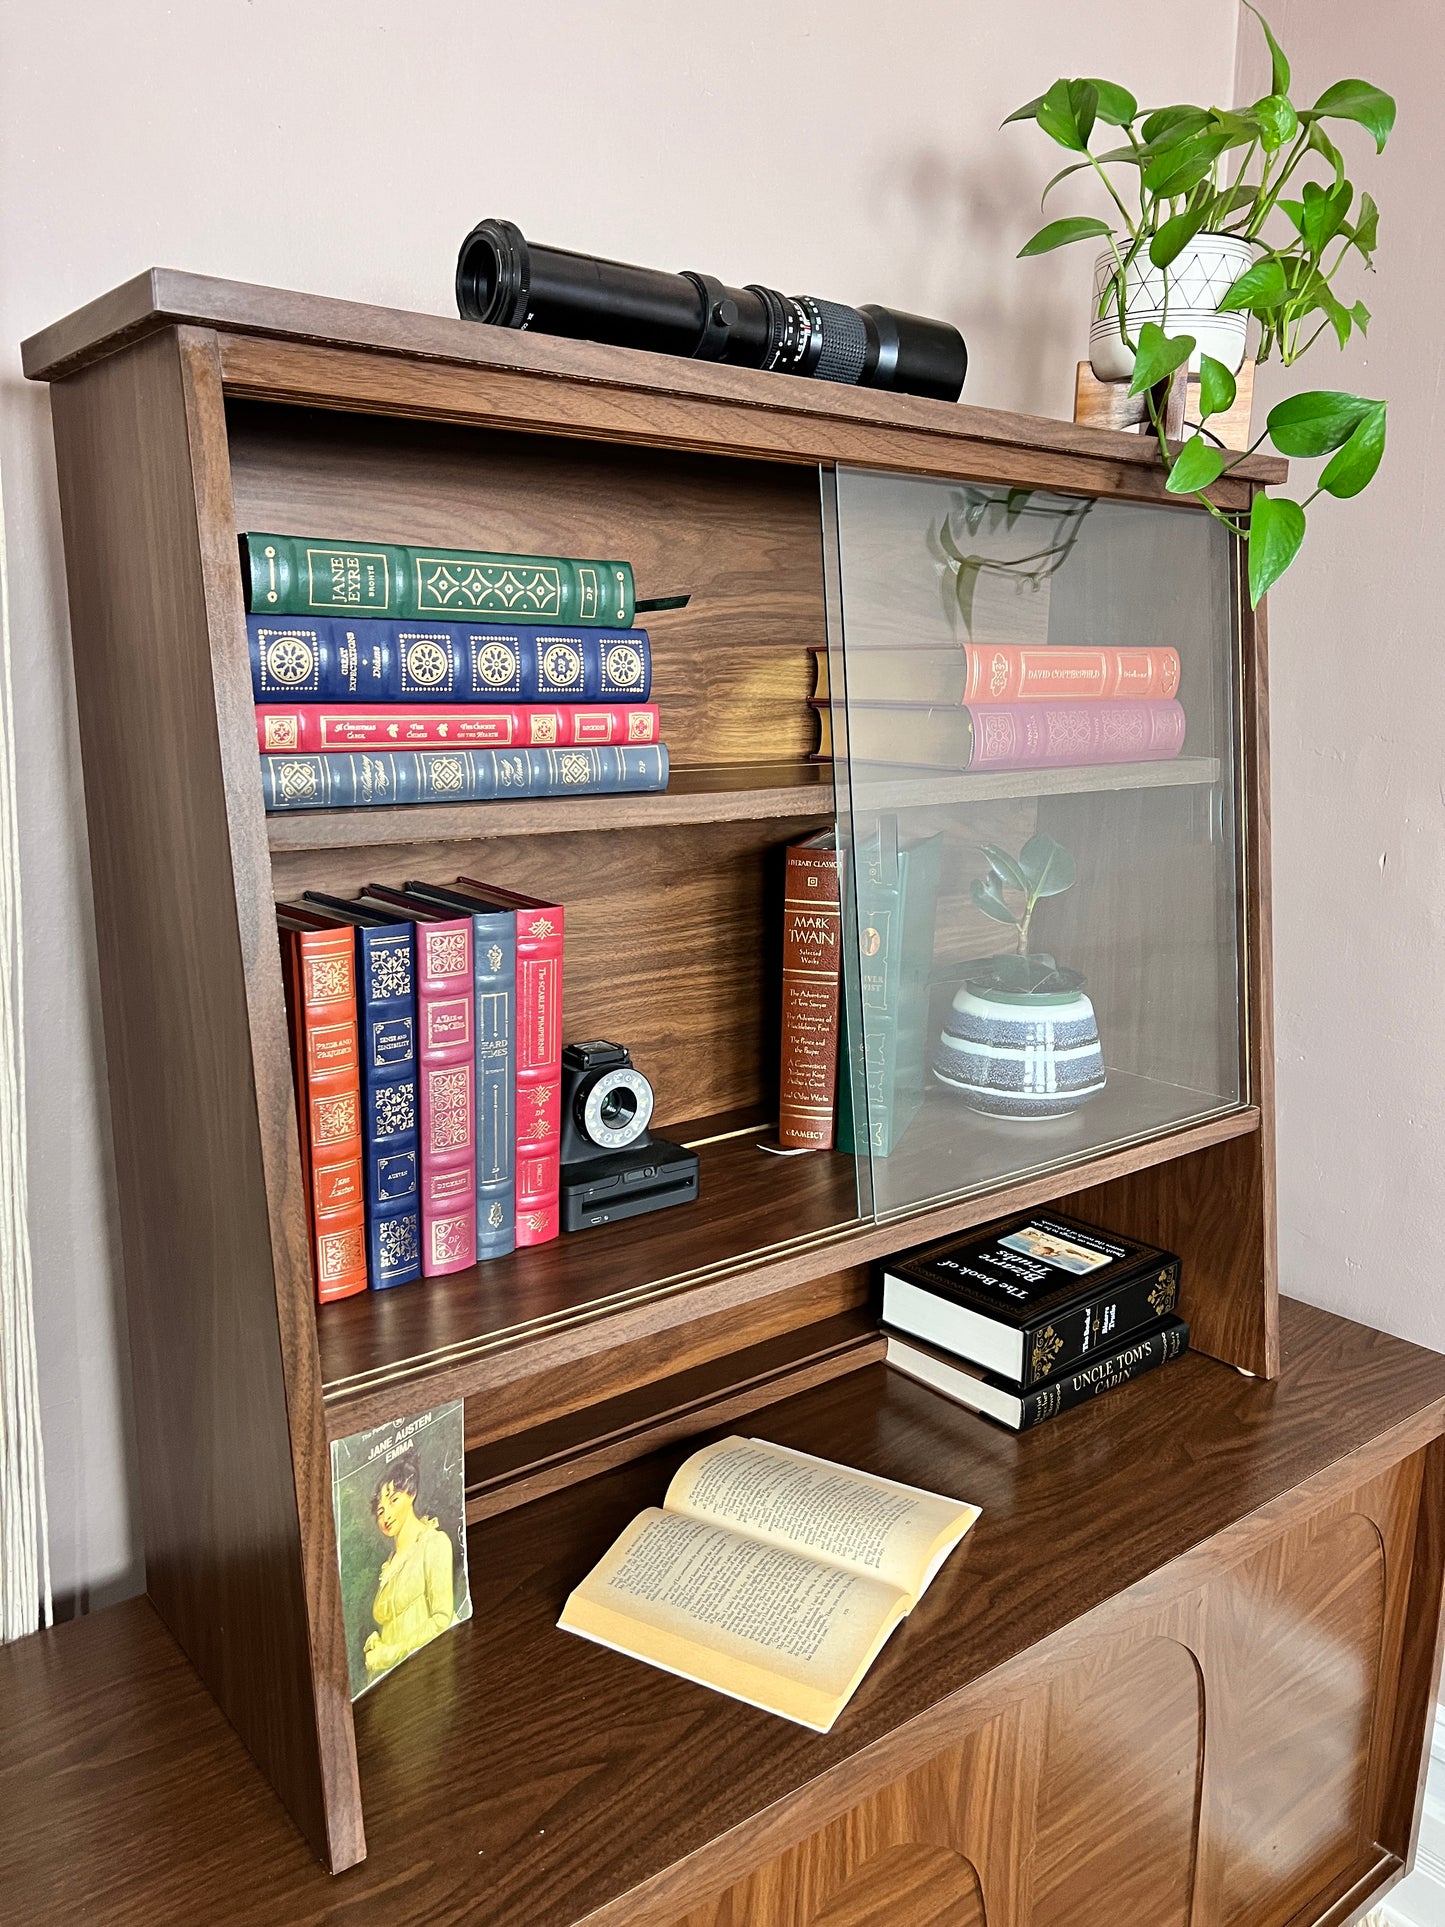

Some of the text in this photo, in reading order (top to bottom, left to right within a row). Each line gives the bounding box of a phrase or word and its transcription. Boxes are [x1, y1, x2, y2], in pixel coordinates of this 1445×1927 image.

[331, 557, 347, 603] JANE
[347, 557, 361, 603] EYRE
[586, 586, 594, 601] DP
[340, 647, 349, 676] GREAT
[346, 631, 357, 691] EXPECTATIONS
[372, 645, 381, 679] Dickens
[1028, 669, 1101, 680] DAVID COPPERFIELD
[794, 916, 829, 929] MARK
[789, 929, 835, 945] TWAIN
[799, 948, 822, 956] Selected
[801, 956, 820, 964] Works
[785, 1130, 824, 1140] GRAMERCY
[448, 1235, 460, 1245] DP
[978, 1253, 1046, 1283] Bizarre
[995, 1250, 1052, 1276] Truths
[937, 1260, 1029, 1300] The Book of
[1085, 1308, 1091, 1317] of
[1083, 1316, 1091, 1336] Book
[1072, 1360, 1114, 1391] UNCLE
[1116, 1341, 1152, 1370] TOM'S
[1094, 1367, 1132, 1395] CABIN
[368, 1411, 432, 1460] JANE AUSTEN
[385, 1438, 414, 1464] EMMA
